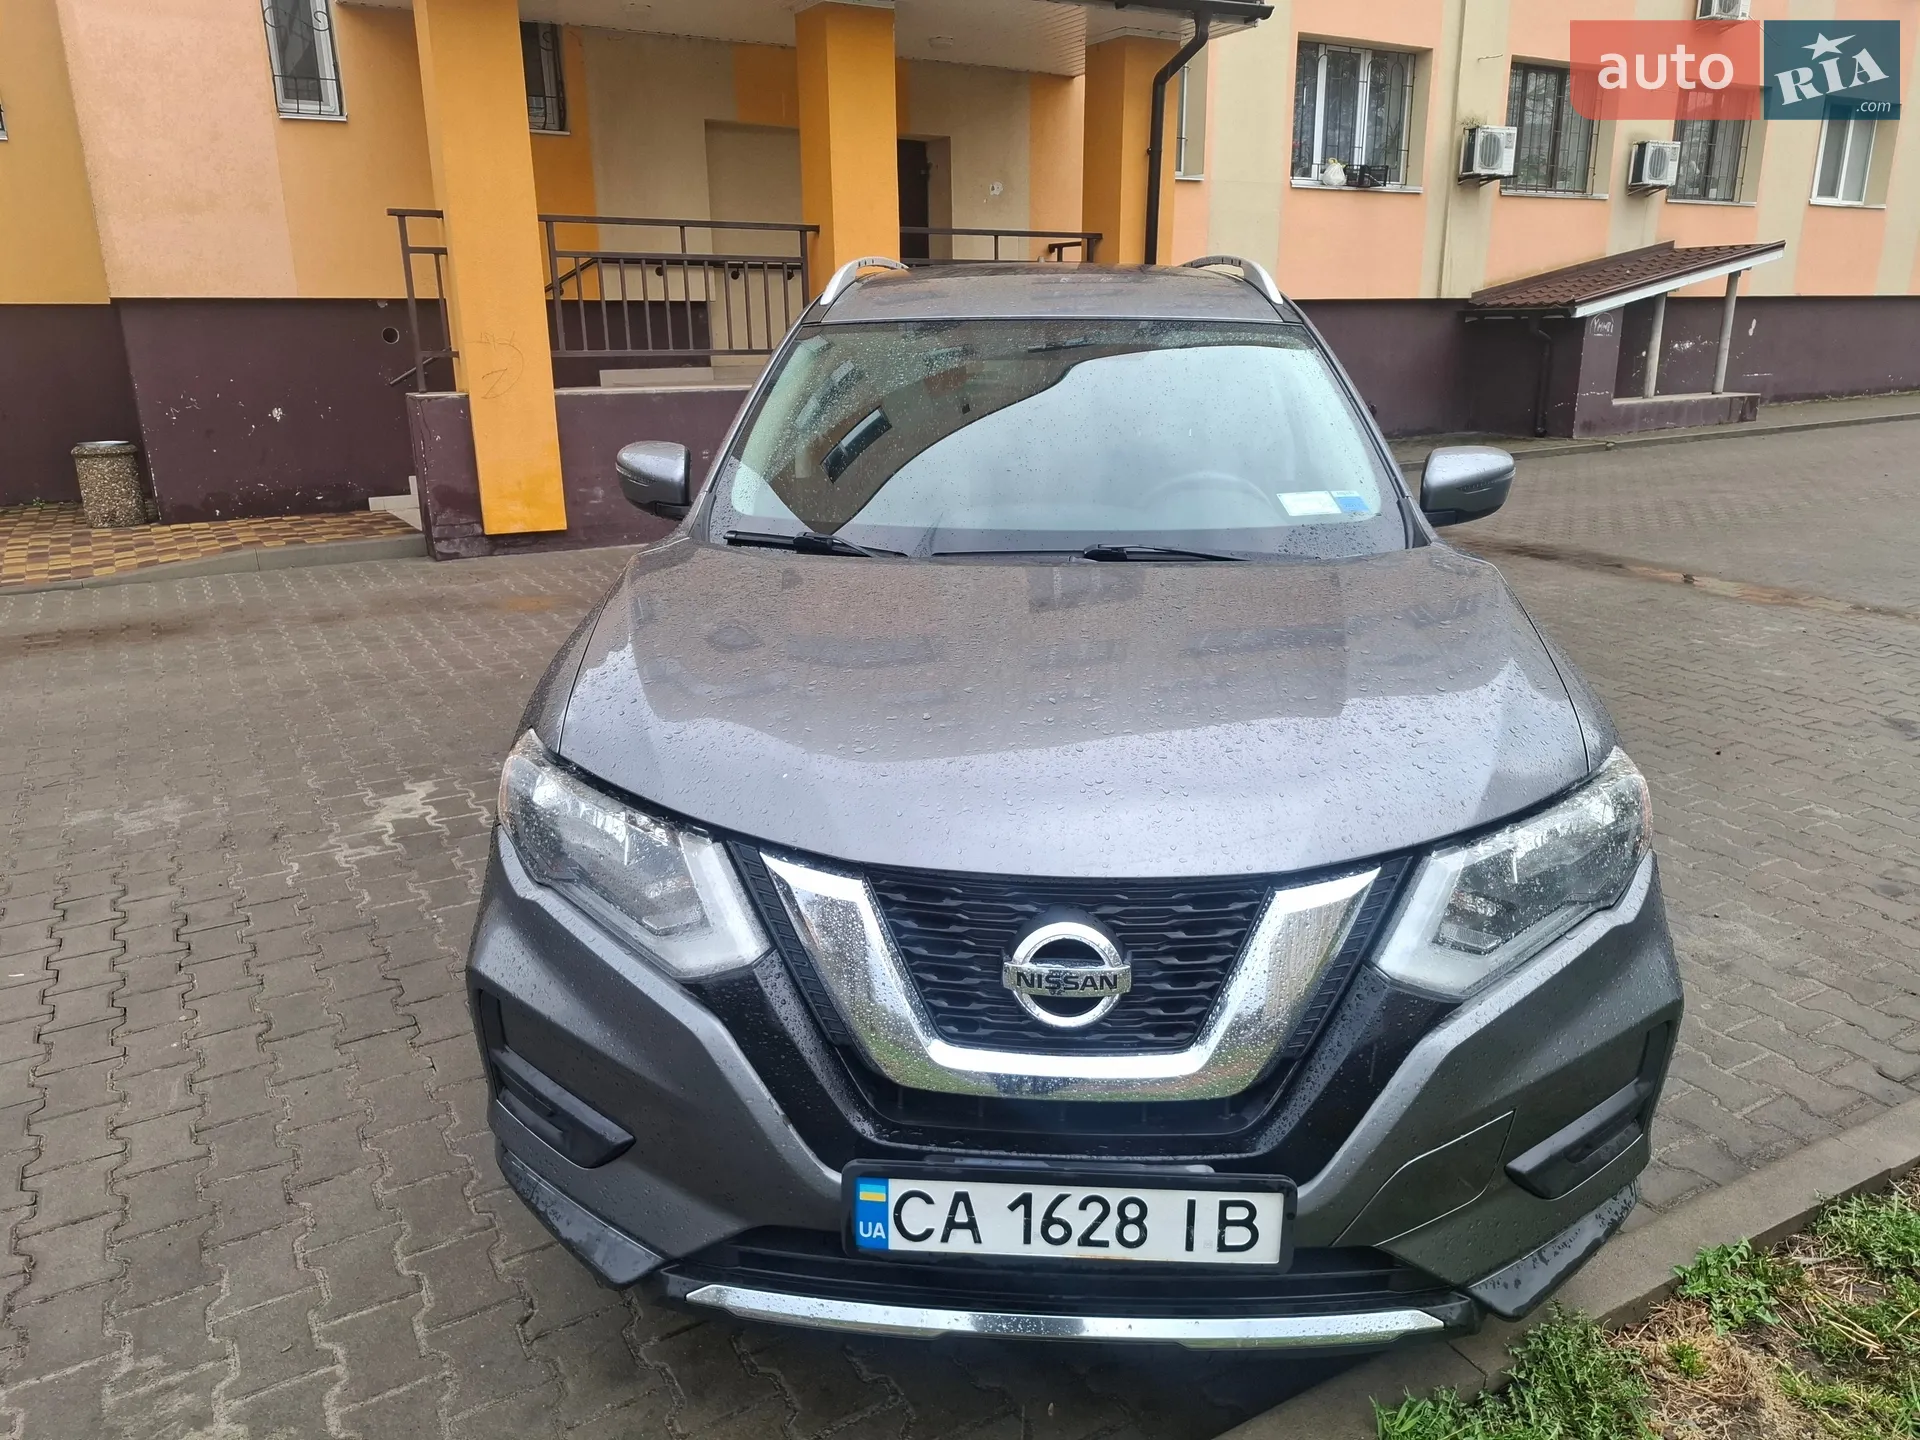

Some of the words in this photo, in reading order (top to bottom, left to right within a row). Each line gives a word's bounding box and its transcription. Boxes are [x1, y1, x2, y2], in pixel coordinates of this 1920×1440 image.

[1016, 971, 1118, 991] NISSAN
[859, 1220, 886, 1240] UA
[893, 1189, 983, 1245] CA
[1006, 1191, 1149, 1249] 1628
[1184, 1198, 1260, 1253] IB
